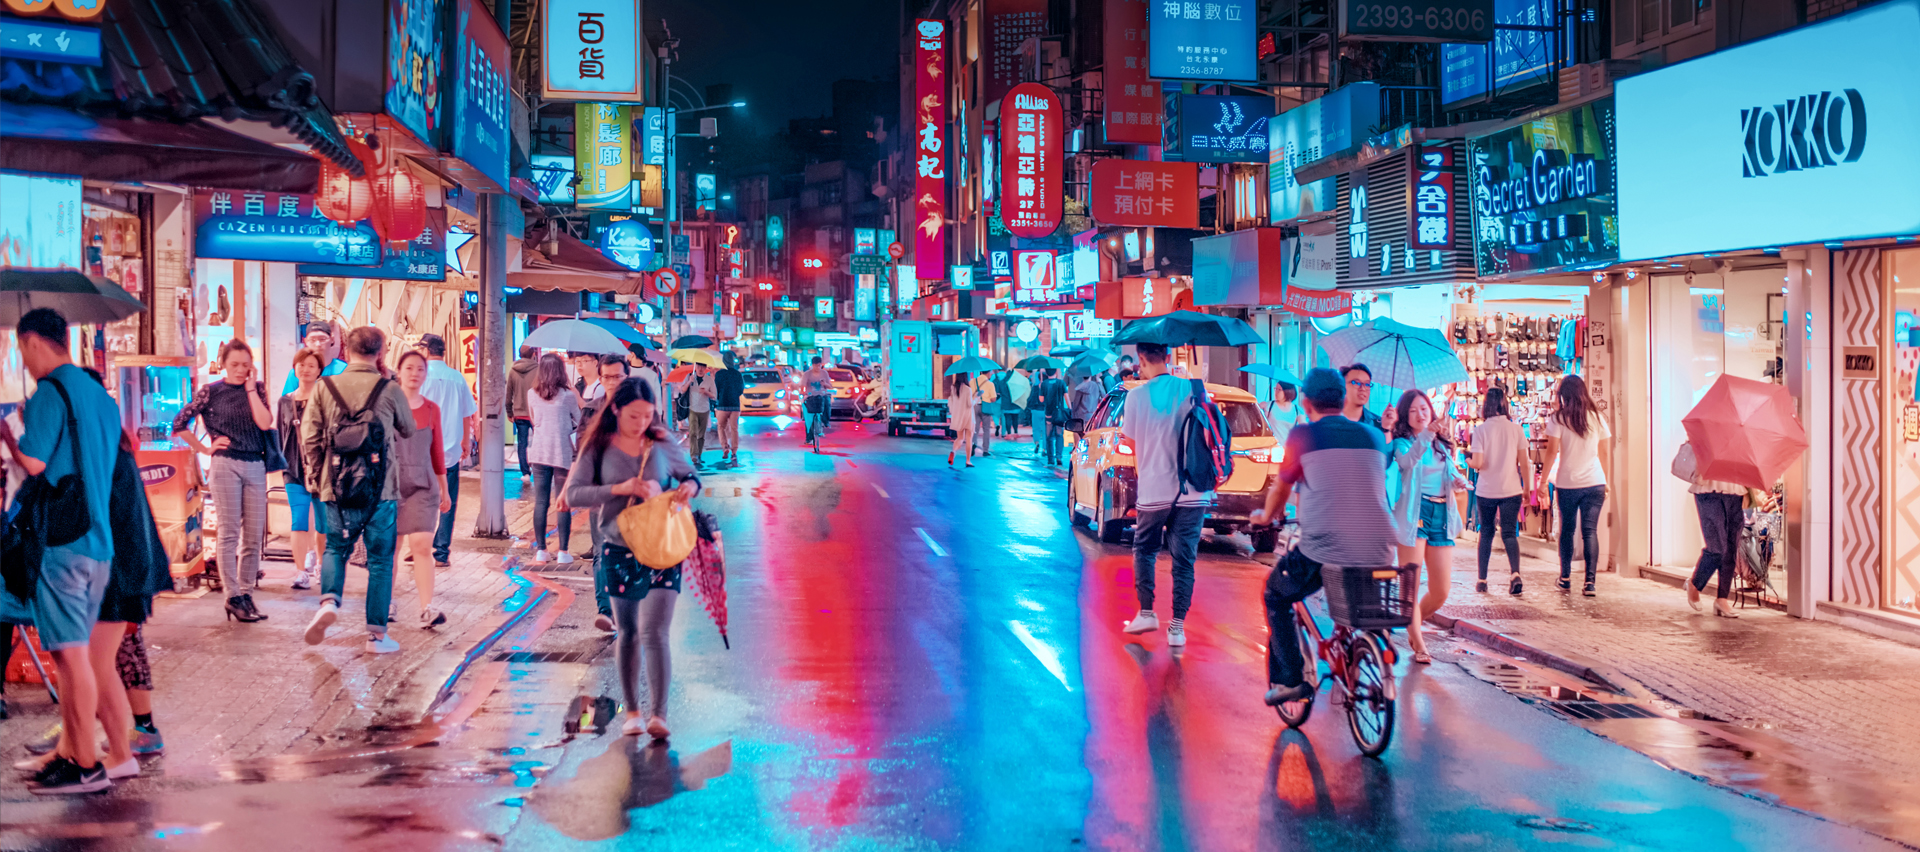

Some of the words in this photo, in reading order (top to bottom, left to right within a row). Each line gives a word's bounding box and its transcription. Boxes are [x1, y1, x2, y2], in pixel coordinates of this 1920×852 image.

[1163, 1, 1242, 21] 神腦數位
[1356, 5, 1485, 31] 2393-6306
[578, 12, 605, 80] 百貨
[1177, 46, 1228, 55] 特約服務中心
[1180, 66, 1224, 75] 2356-8787
[1124, 84, 1154, 98] 媒體
[1740, 88, 1867, 178] KOKKO
[917, 122, 944, 179] 高記
[1114, 171, 1174, 191] 上網卡
[1480, 165, 1531, 217] Secret
[1532, 149, 1596, 205] Garden
[1019, 200, 1035, 209] 2F
[1114, 195, 1174, 216] 預付卡
[218, 221, 265, 233] CAZEN
[1011, 219, 1054, 228] 2351-3650
[336, 244, 375, 259] 永康店
[407, 264, 438, 275] 永康店
[1904, 405, 1920, 442] 週
